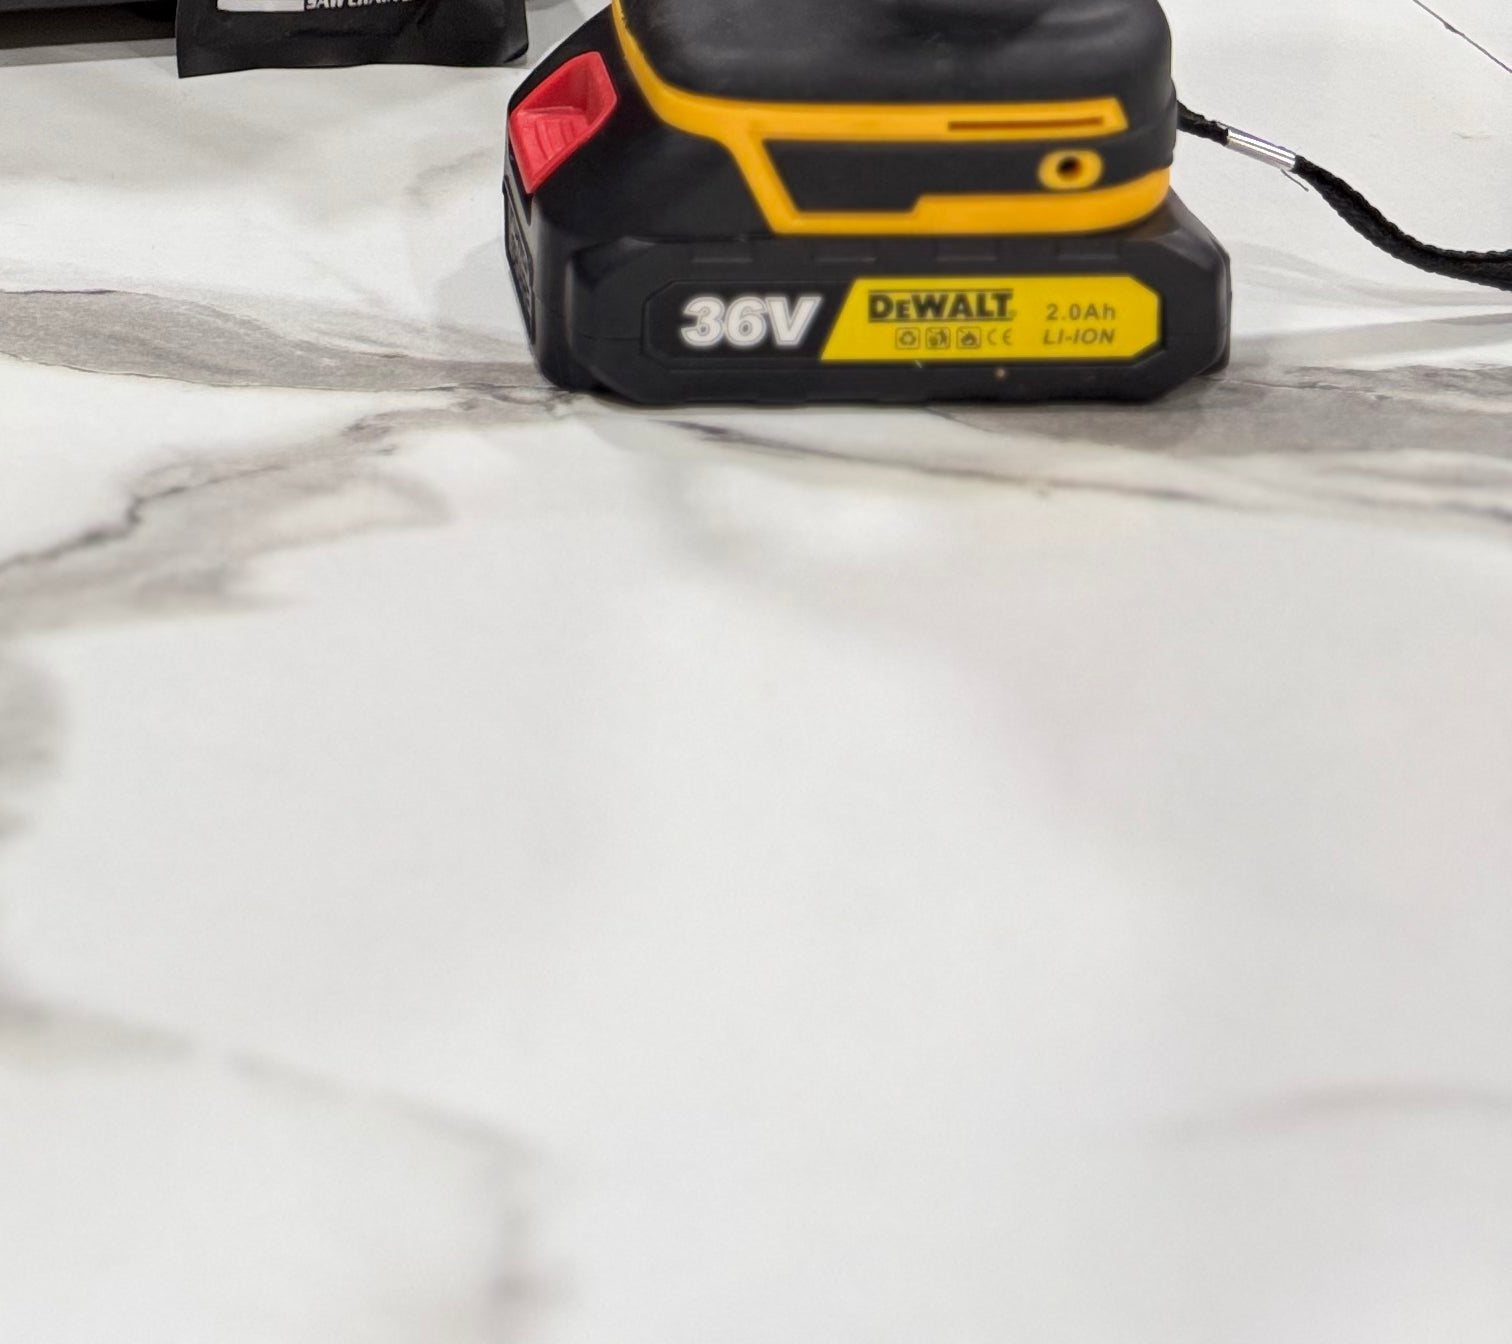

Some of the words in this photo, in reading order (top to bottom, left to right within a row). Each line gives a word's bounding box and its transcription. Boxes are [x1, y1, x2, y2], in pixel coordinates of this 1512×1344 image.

[680, 292, 822, 349] 36V
[1046, 303, 1116, 322] 2.0Ah
[1043, 328, 1116, 346] LI-ION
